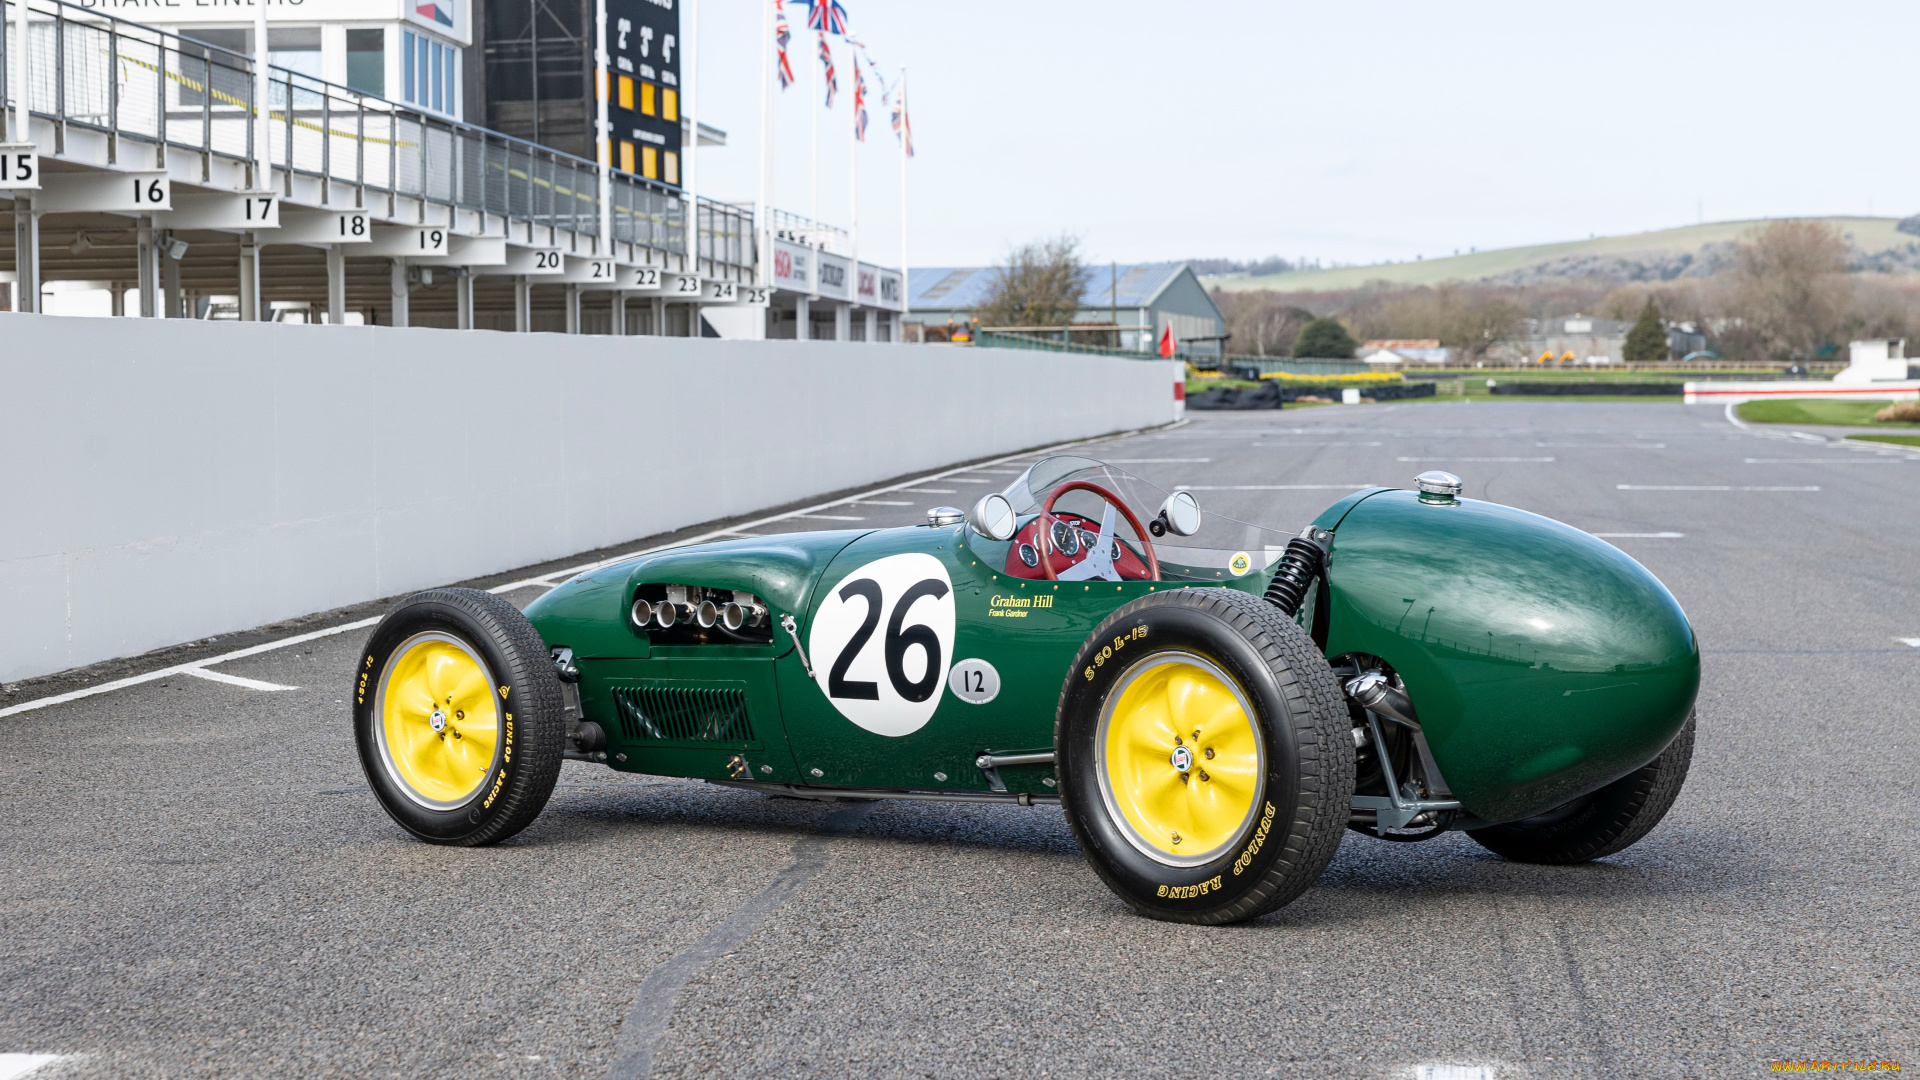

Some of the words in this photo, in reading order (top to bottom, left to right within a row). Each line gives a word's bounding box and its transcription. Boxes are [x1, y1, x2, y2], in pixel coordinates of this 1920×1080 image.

[1, 154, 32, 181] 15
[134, 179, 164, 203] 16
[246, 199, 272, 220] 17
[340, 215, 365, 236] 18
[420, 230, 442, 249] 19
[536, 251, 559, 268] 20
[592, 262, 611, 277] 21
[636, 269, 656, 285] 22
[679, 277, 697, 292] 23
[714, 283, 732, 297] 24
[748, 289, 765, 303] 25
[990, 594, 1030, 608] Graham
[1032, 594, 1054, 608] Hill
[988, 608, 1005, 616] Frank
[1005, 608, 1028, 618] Gardner
[828, 578, 949, 703] 26
[964, 670, 985, 692] 12
[504, 712, 514, 763] DUNLOP
[483, 768, 507, 809] RACING
[1233, 800, 1276, 876] DUNLOP
[1156, 875, 1222, 899] RACING
